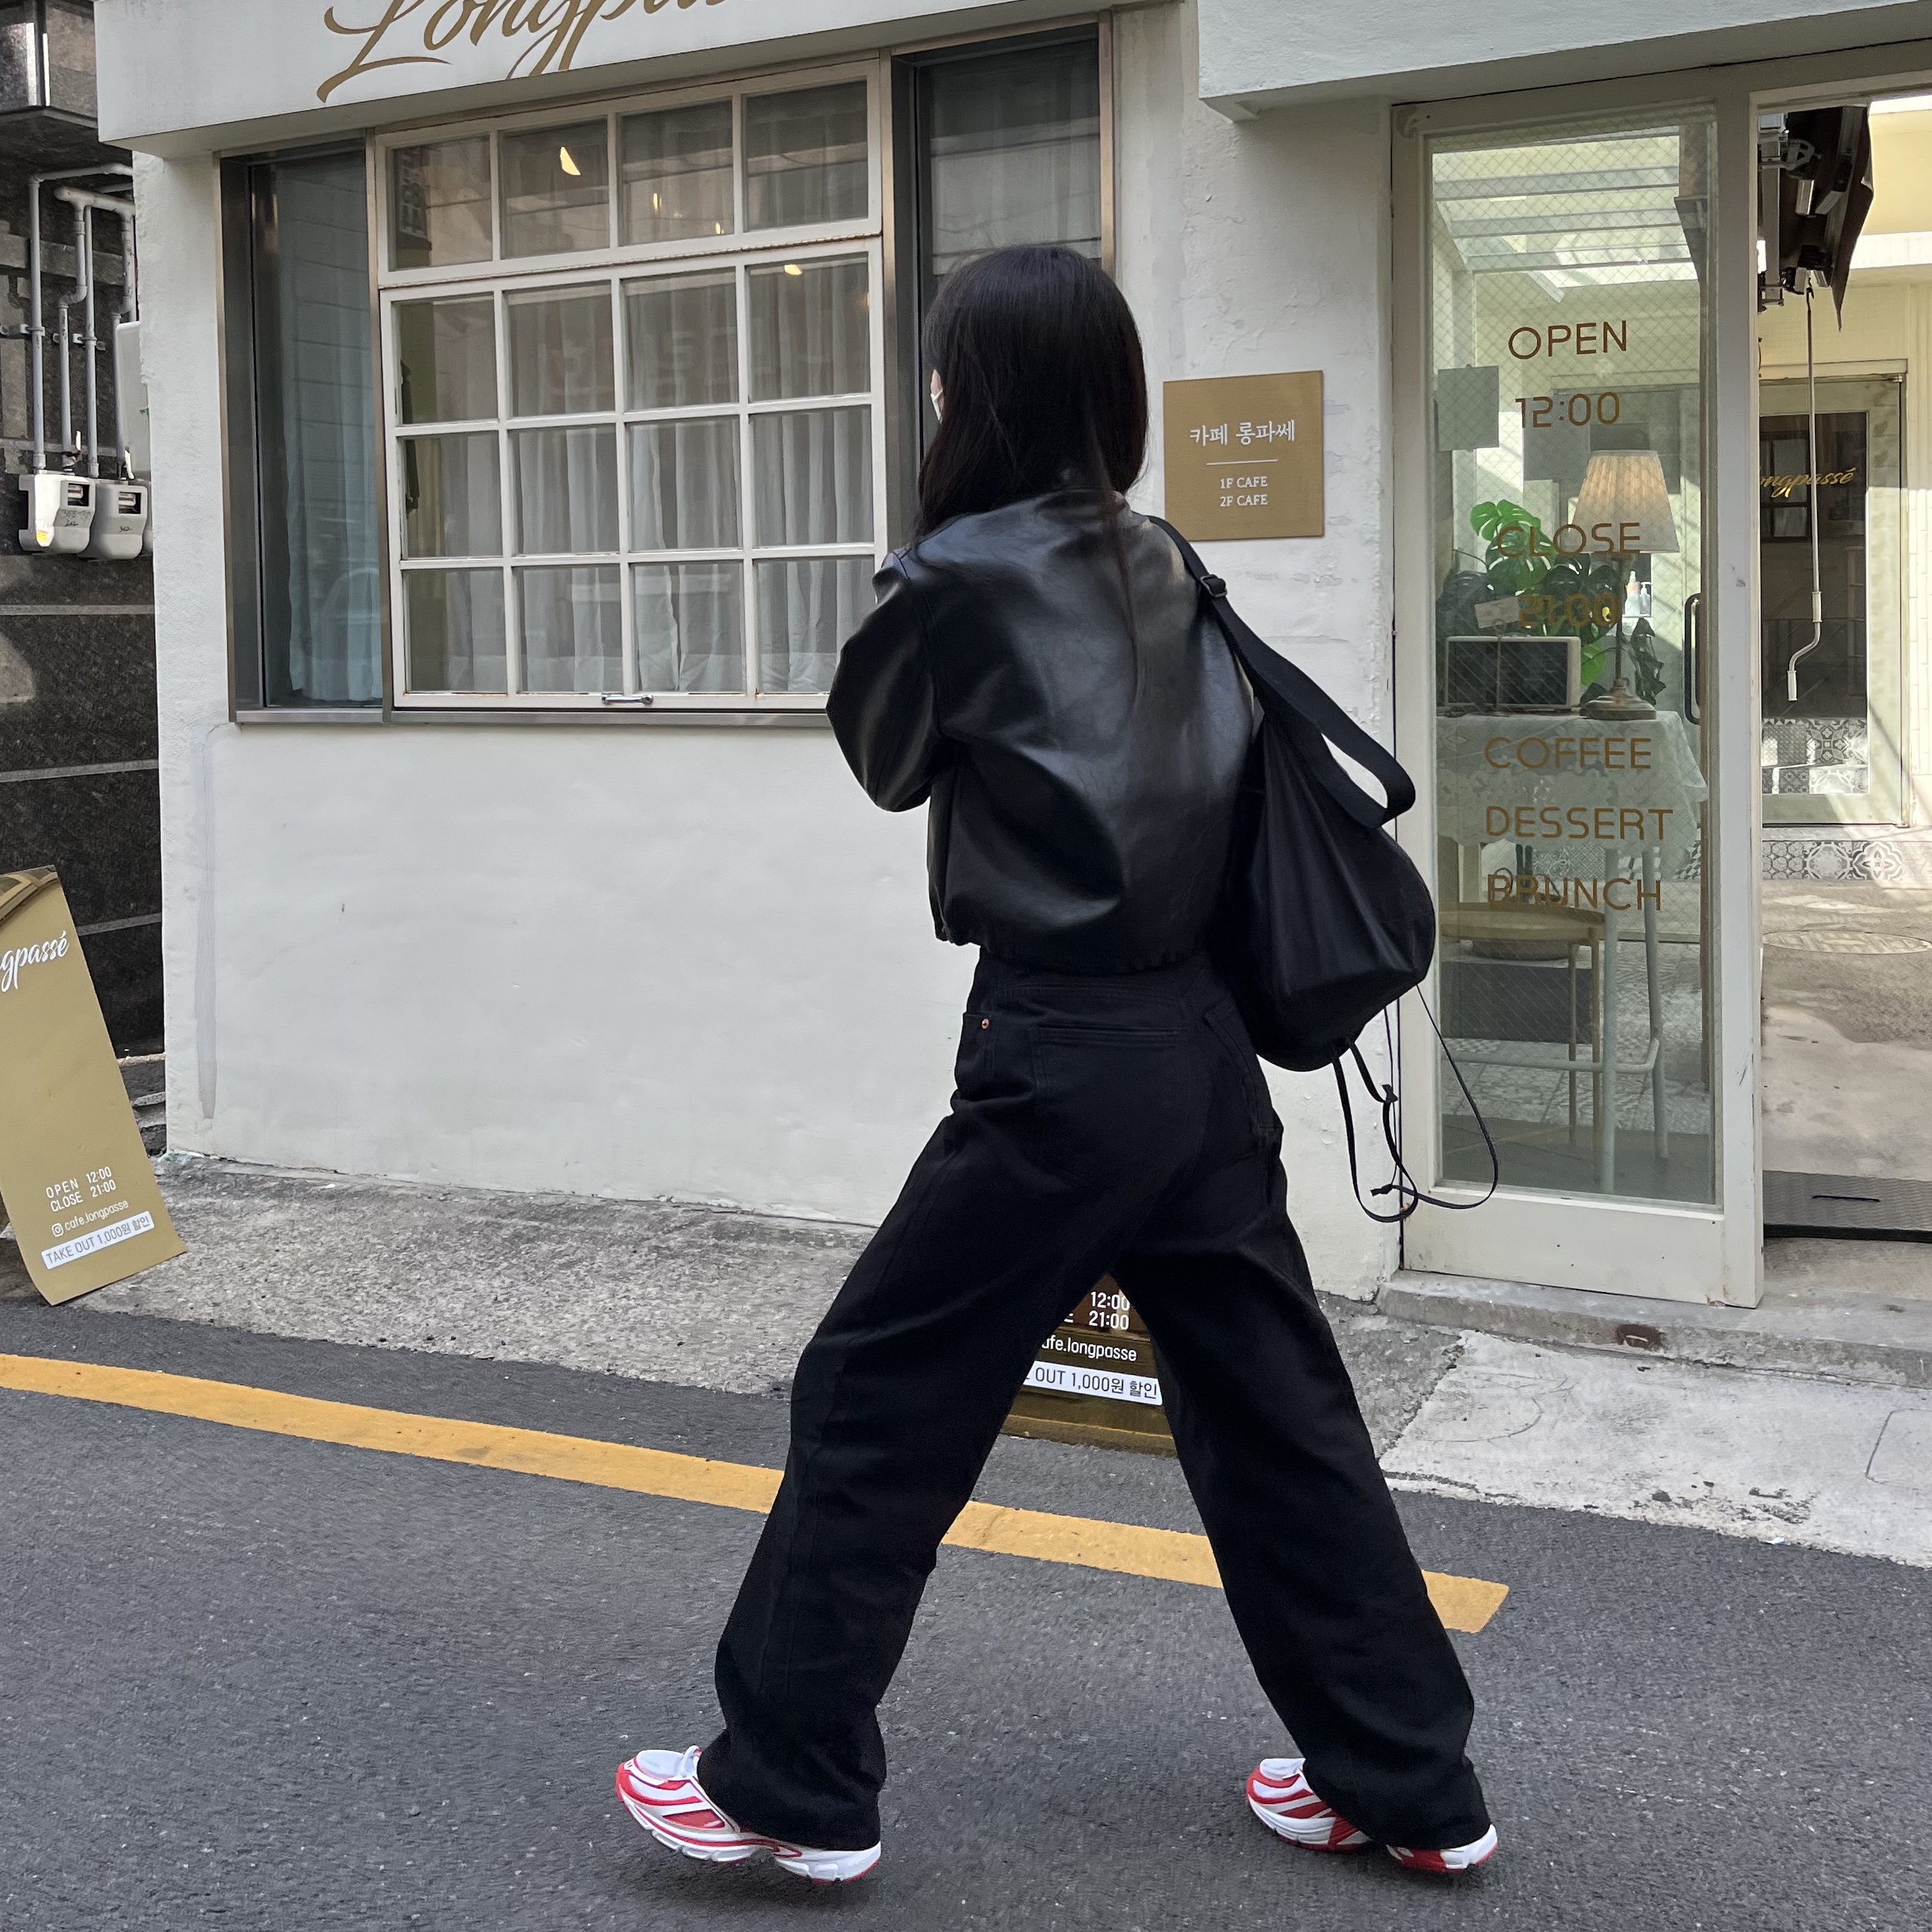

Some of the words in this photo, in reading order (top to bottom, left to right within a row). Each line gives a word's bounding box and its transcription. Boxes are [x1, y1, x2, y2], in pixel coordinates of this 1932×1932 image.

[316, 0, 726, 103] Longp
[1508, 320, 1627, 360] OPEN
[1515, 391, 1620, 429] 12:00
[1189, 423, 1228, 447] 카페
[1236, 419, 1295, 446] 롱파쎄
[1220, 477, 1233, 489] 1F
[1236, 476, 1268, 488] CAFE
[1220, 496, 1233, 507] 2F
[1237, 494, 1268, 506] CAFE
[1497, 522, 1641, 558] CLOSE
[1484, 736, 1651, 769] COFFEE
[1486, 805, 1674, 841] DESSERT
[1487, 874, 1662, 911] BRUNCH
[0, 931, 69, 993] gpassé
[46, 1178, 79, 1199] OPEN
[85, 1166, 112, 1184] 12:00
[50, 1191, 84, 1212] CLOSE
[90, 1179, 117, 1198] 21:00
[64, 1200, 129, 1231] cafe.longpasse
[46, 1245, 74, 1264] TAKE
[75, 1237, 95, 1253] OUT
[96, 1223, 131, 1245] 1,000원
[1090, 1291, 1131, 1311] 12:00
[1089, 1310, 1129, 1330] 21:00
[1035, 1367, 1066, 1385] OUT
[1072, 1373, 1125, 1394] 1,000원
[1129, 1381, 1157, 1400] 할인
